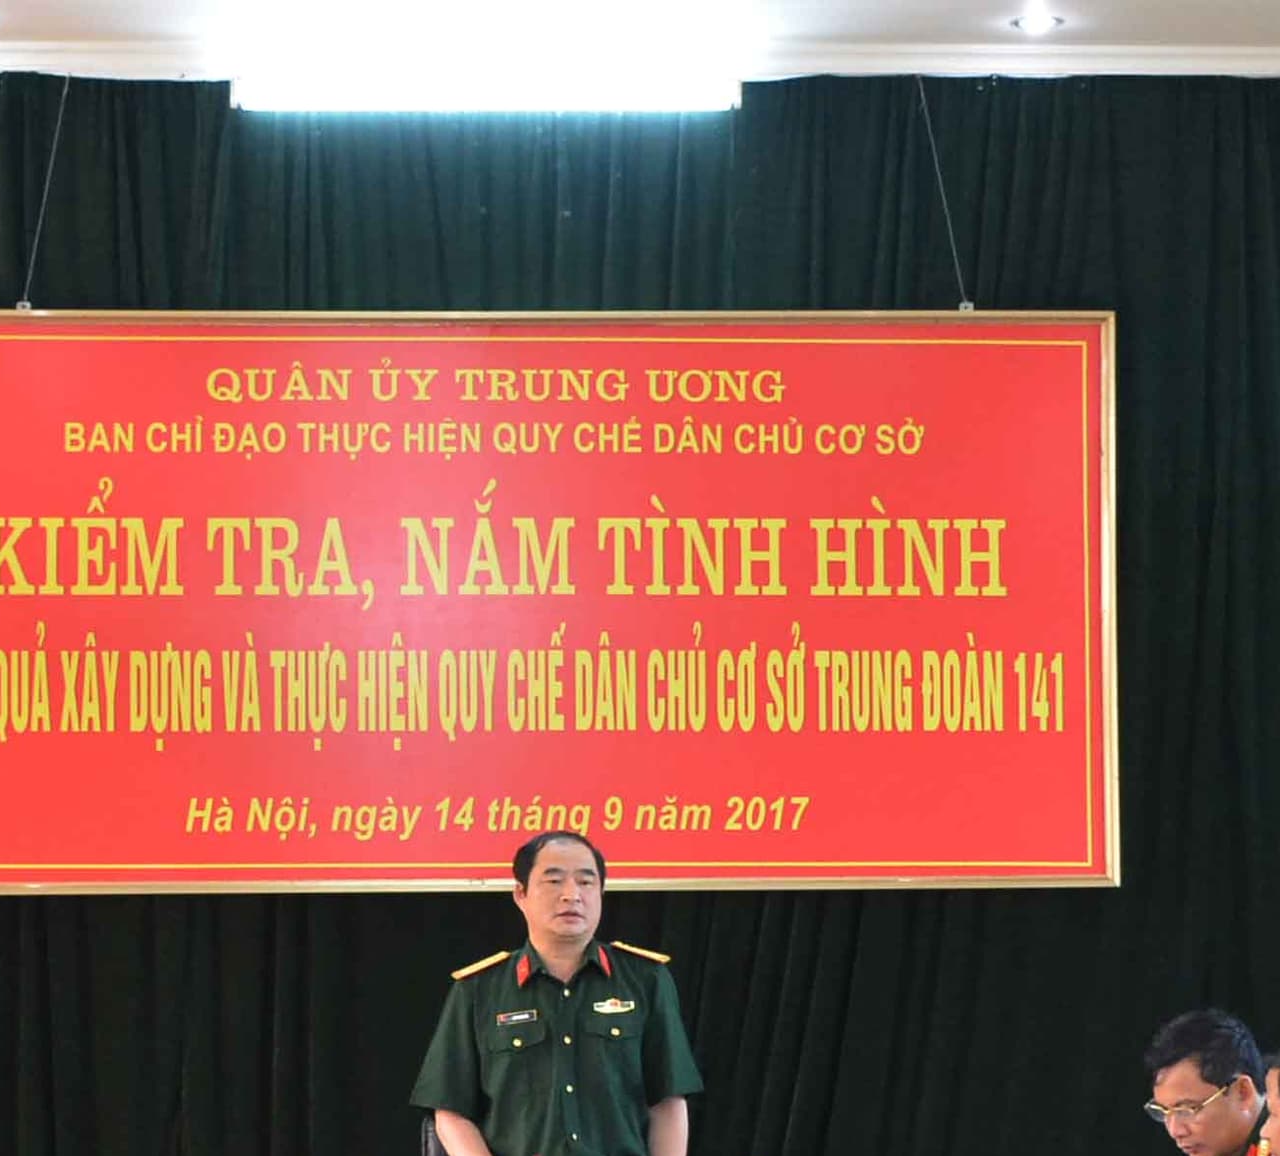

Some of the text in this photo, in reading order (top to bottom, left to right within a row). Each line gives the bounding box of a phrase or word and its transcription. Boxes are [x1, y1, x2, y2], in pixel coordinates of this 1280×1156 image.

[206, 358, 785, 403] QUÂN ỦY TRUNG ƯƠNG
[64, 415, 925, 459] BAN CHỈ ĐẠO THỰC HIỆN QUY CHẾ DÂN CHỦ CƠ SỞ
[206, 516, 375, 609] TRA,
[401, 479, 576, 596] NẮM
[597, 495, 788, 596] TÌNH
[809, 495, 1008, 597] HÌNH
[60, 631, 120, 732] XÂY
[129, 641, 212, 752] DỰNG
[221, 631, 262, 732] VÀ
[269, 641, 348, 752] THỰC
[357, 633, 430, 751] HIỆN
[439, 650, 498, 741] QUY
[507, 623, 567, 732] CHẾ
[574, 631, 637, 731] DÂN
[647, 621, 707, 733] CHỦ
[716, 641, 757, 733] CƠ
[766, 621, 806, 733] SỞ
[814, 649, 913, 733] TRUNG
[921, 632, 1004, 733] ĐOÀN
[1014, 652, 1064, 732] 141
[185, 796, 810, 842] Hà Nội, ngày 14 tháng 9 năm 2017
